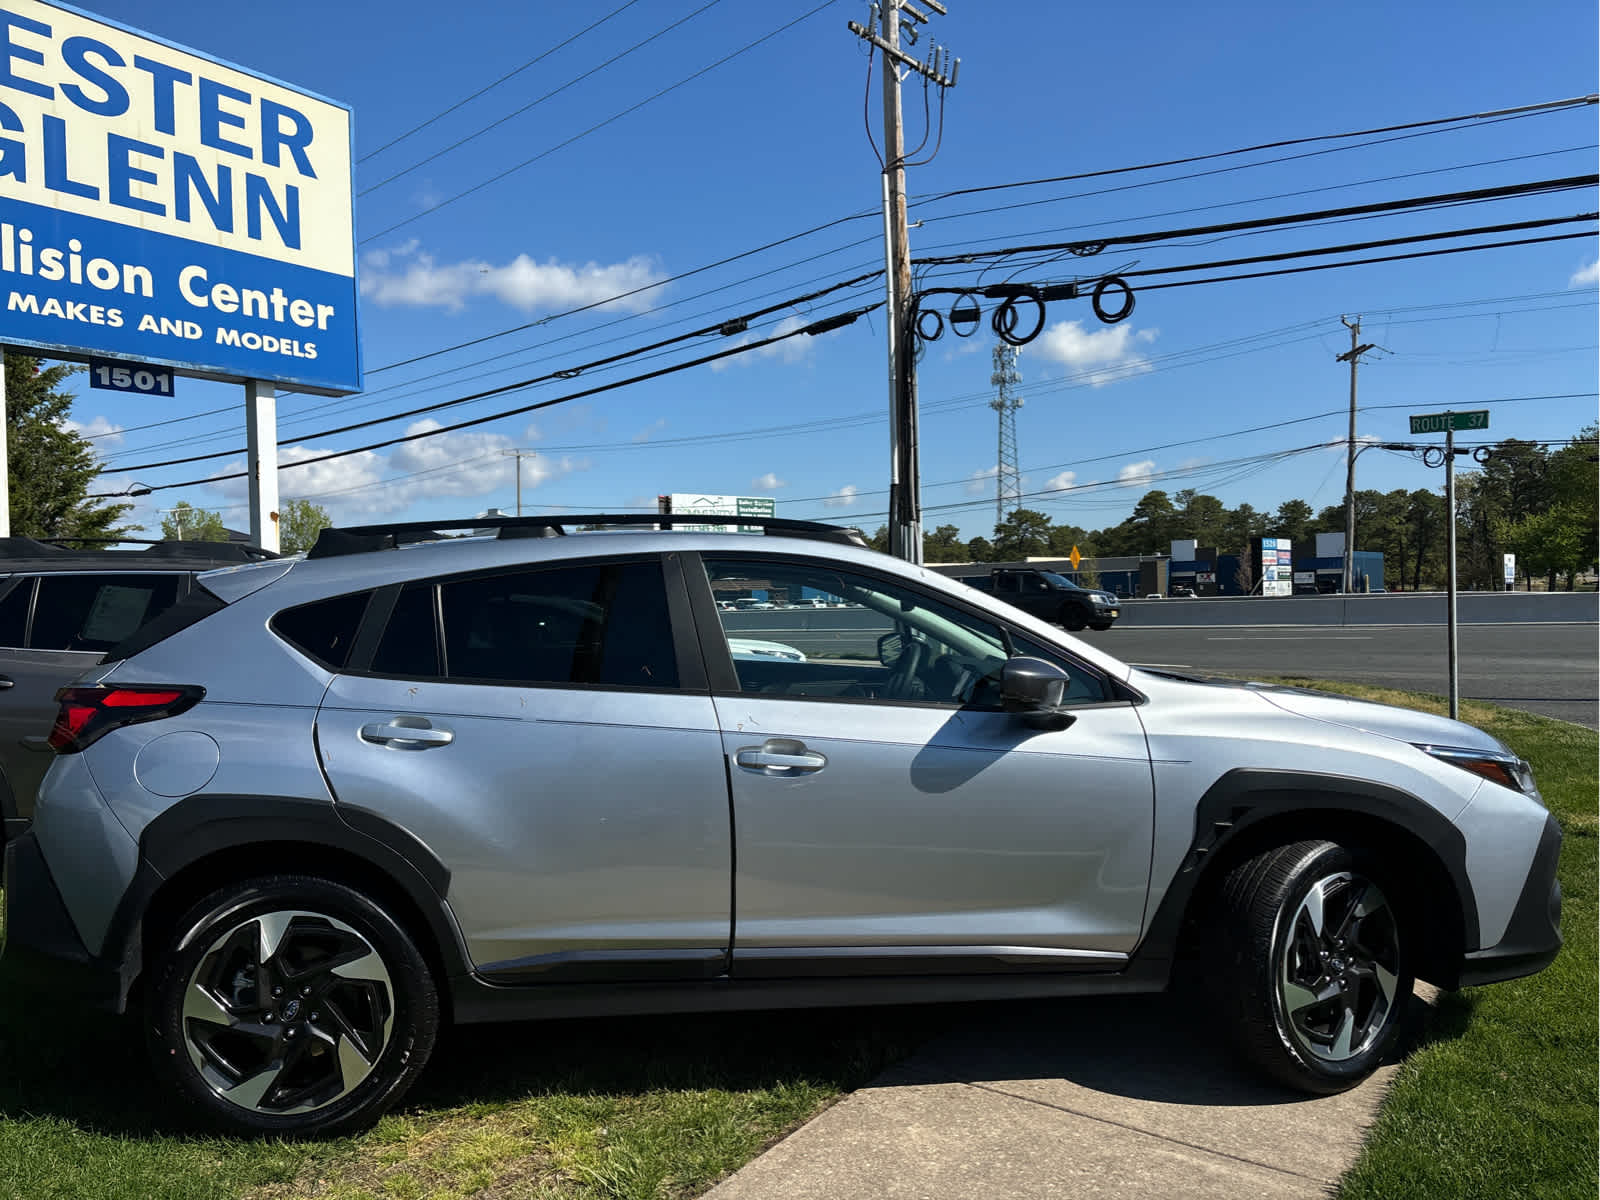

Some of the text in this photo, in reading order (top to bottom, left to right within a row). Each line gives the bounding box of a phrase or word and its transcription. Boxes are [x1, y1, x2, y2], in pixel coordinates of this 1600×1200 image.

[0, 8, 319, 180] ESTER
[1, 223, 335, 331] lision Center
[7, 292, 318, 360] MAKES AND MODELS
[95, 367, 171, 393] 1501
[1412, 413, 1485, 432] ROUTE 37
